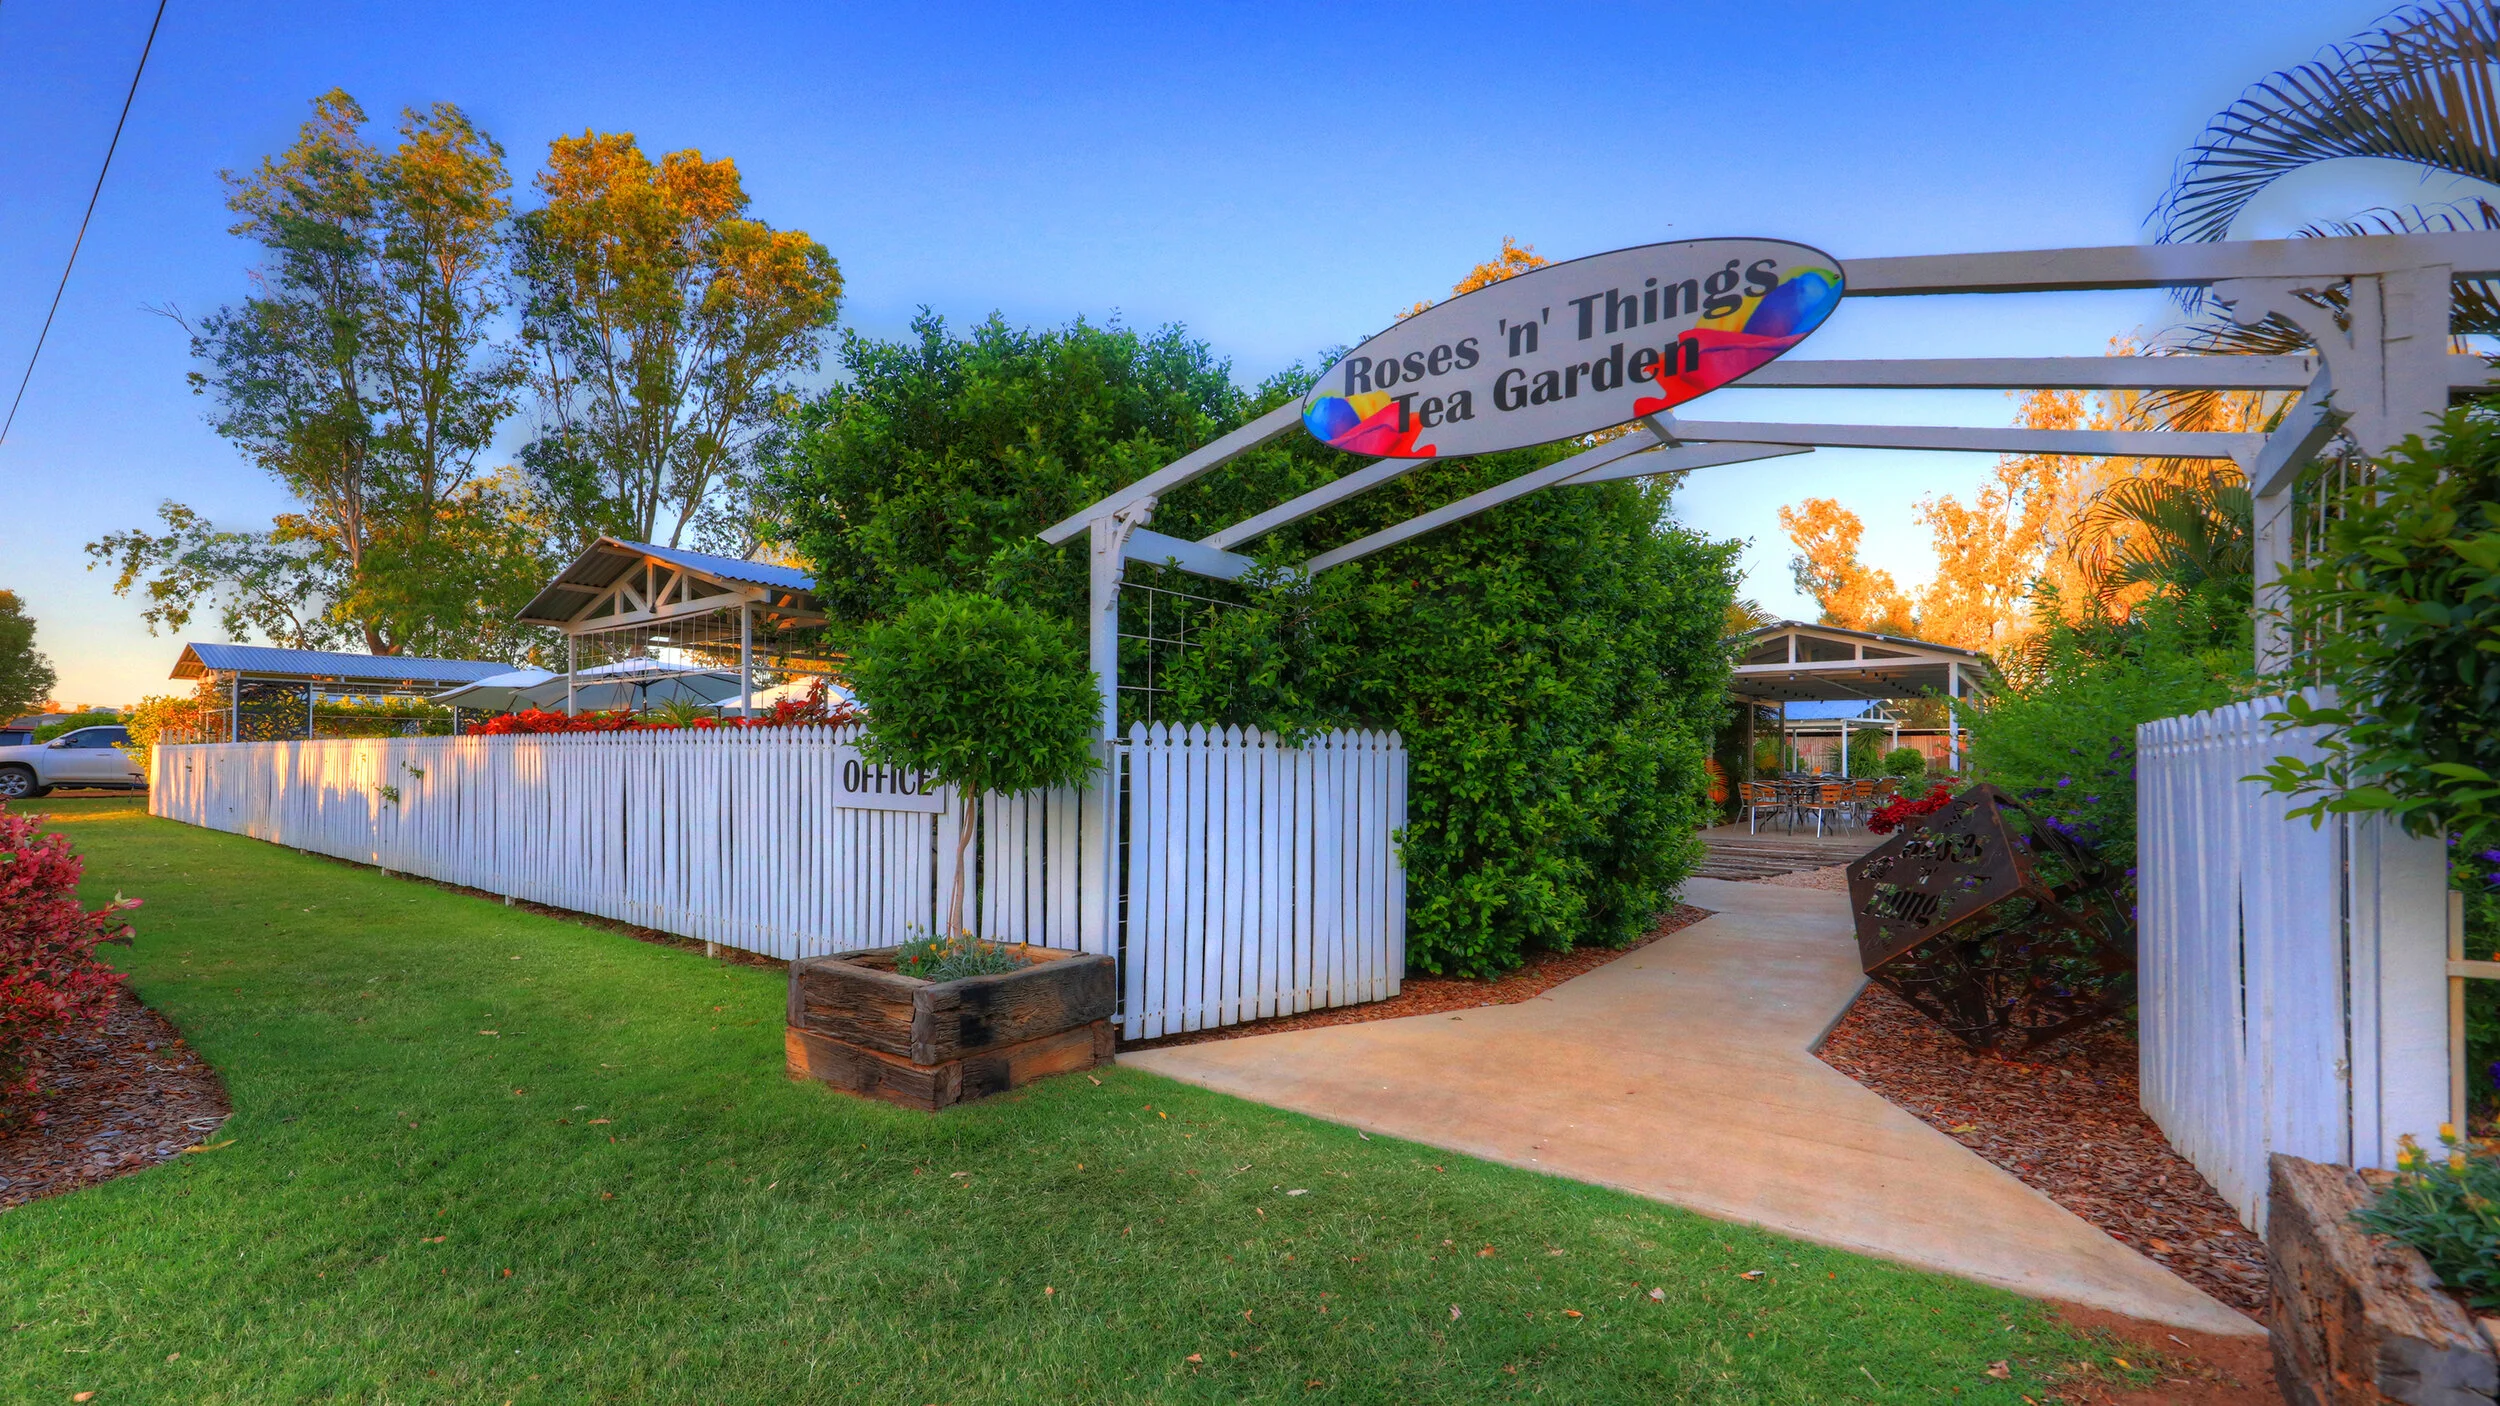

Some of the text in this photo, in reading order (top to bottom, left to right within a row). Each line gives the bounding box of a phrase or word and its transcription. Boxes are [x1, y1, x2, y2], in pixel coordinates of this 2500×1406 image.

[1345, 259, 1779, 397] Roses 'n' Things
[1391, 336, 1700, 433] Tea Garden
